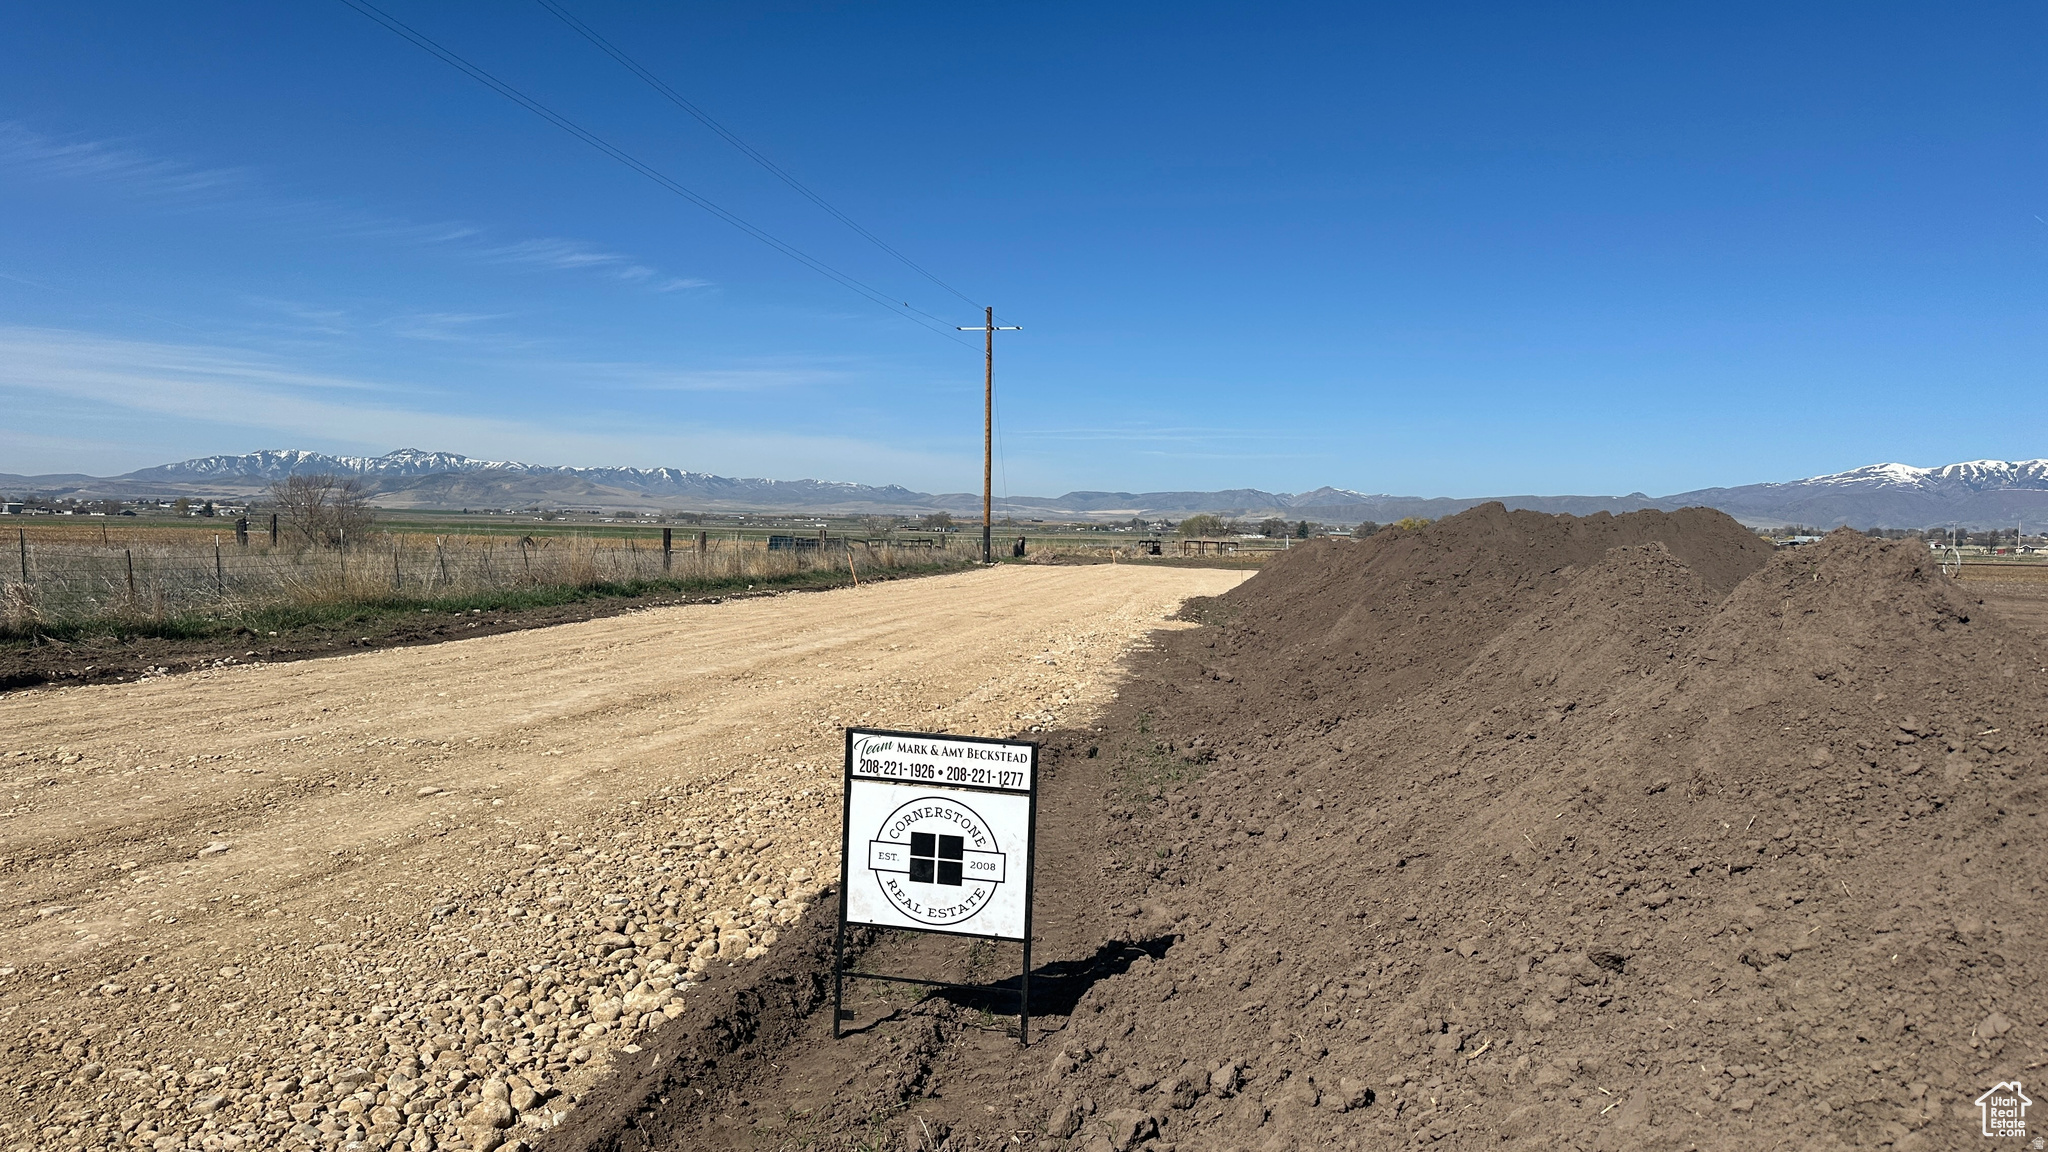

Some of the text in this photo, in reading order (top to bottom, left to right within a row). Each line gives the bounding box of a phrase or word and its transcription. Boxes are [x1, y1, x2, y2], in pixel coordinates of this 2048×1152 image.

[854, 735, 894, 759] Team
[897, 742, 928, 756] MARK
[930, 744, 939, 756] &
[967, 747, 1028, 764] BECKSTEAD
[859, 759, 1024, 787] 208-221-1926 208-221-1277
[889, 806, 987, 848] CORNERSTONE
[878, 851, 900, 862] EST.
[969, 861, 996, 871] 2008
[886, 878, 986, 919] REAL ESTATE
